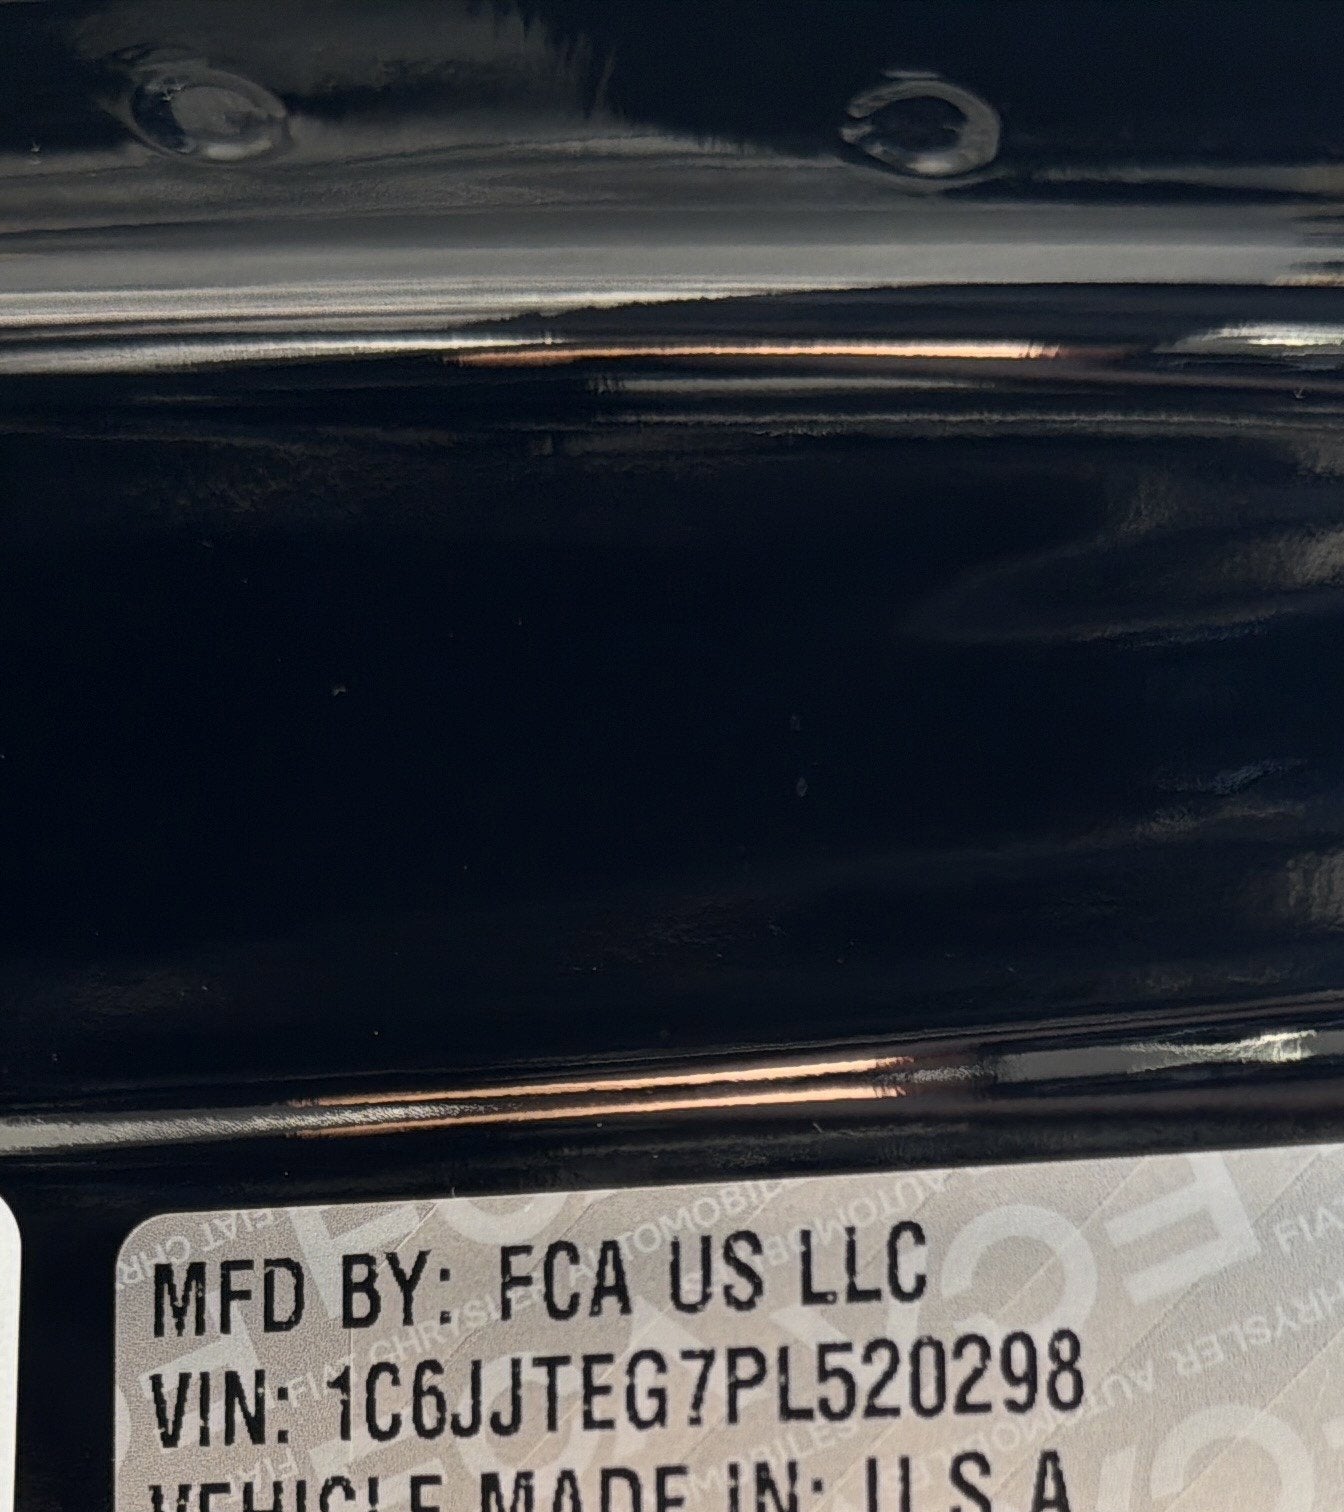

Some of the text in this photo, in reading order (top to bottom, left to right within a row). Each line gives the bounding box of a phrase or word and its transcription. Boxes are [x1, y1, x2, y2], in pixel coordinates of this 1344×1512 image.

[154, 1220, 927, 1338] MFD BY: FCA US LLC
[150, 1327, 1084, 1448] VIN: 1C6JJTEG7PL520298
